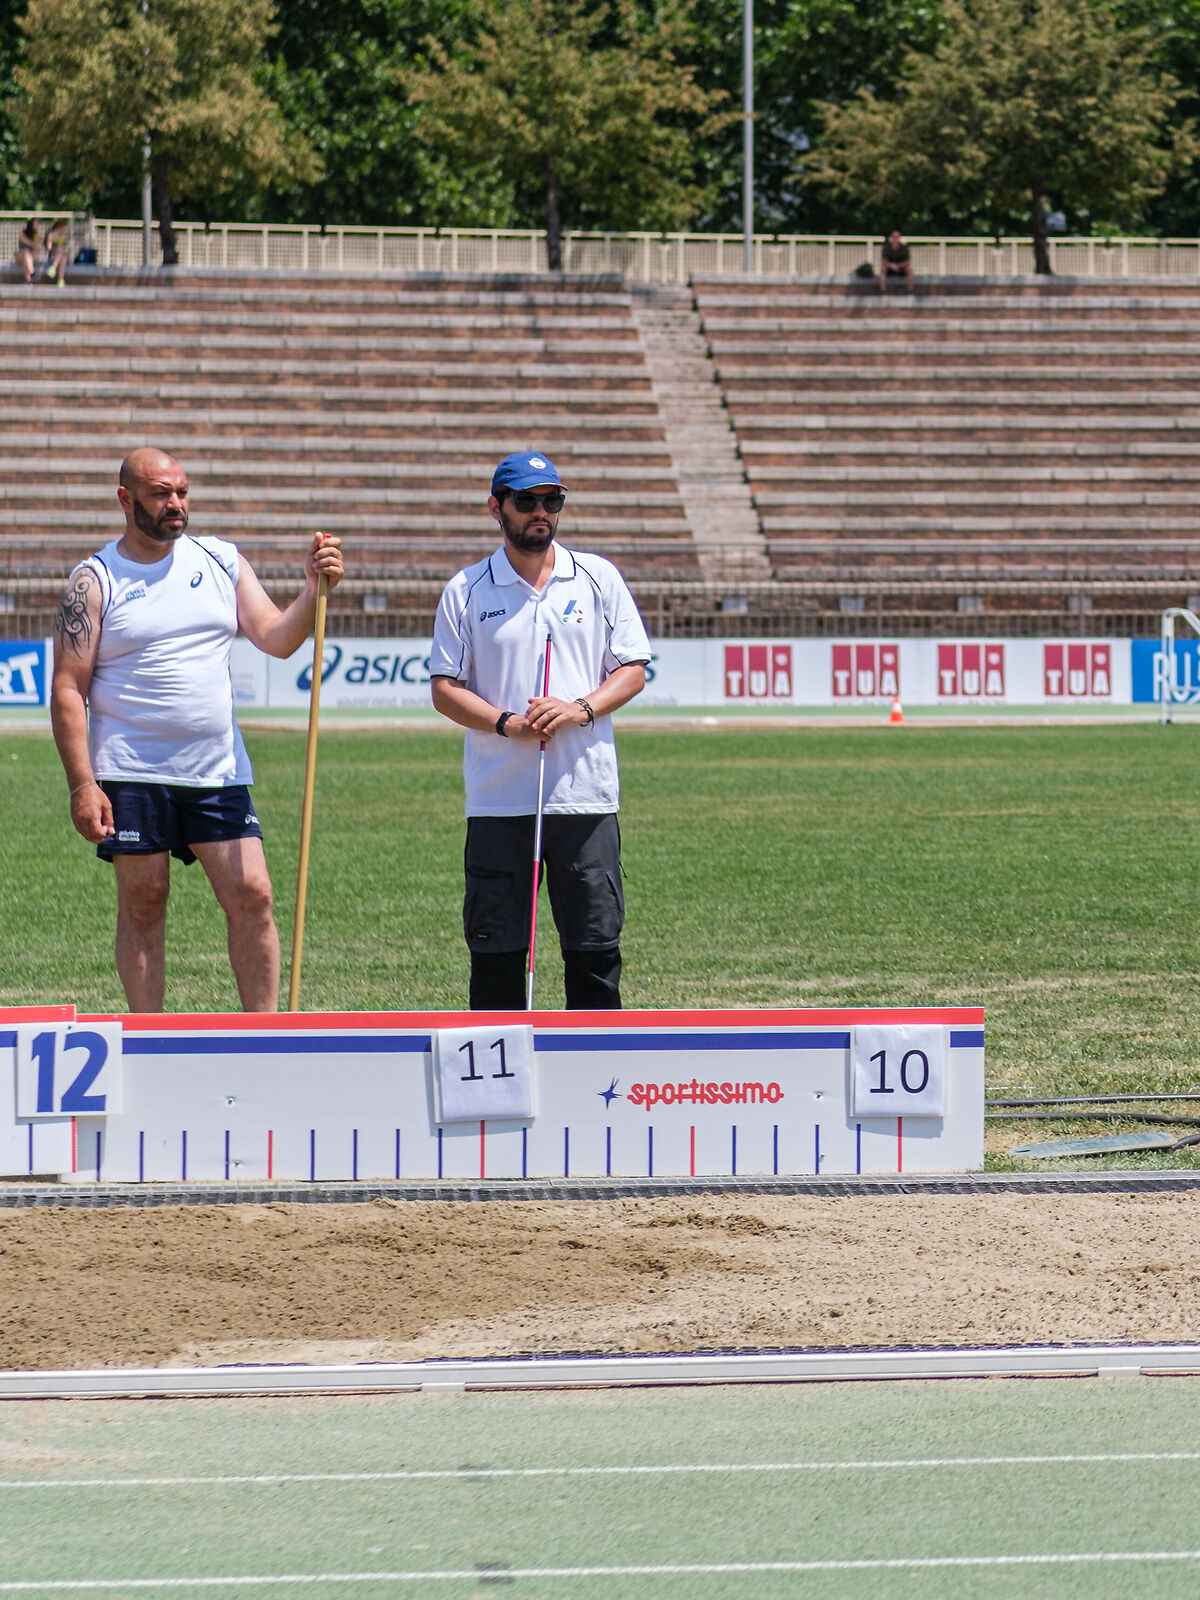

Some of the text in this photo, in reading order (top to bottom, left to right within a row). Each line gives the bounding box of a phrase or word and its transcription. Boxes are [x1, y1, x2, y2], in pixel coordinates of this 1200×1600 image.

[31, 1031, 109, 1113] 12
[459, 1038, 515, 1081] 11
[869, 1049, 929, 1094] 10
[627, 1078, 784, 1111] sportissimo
